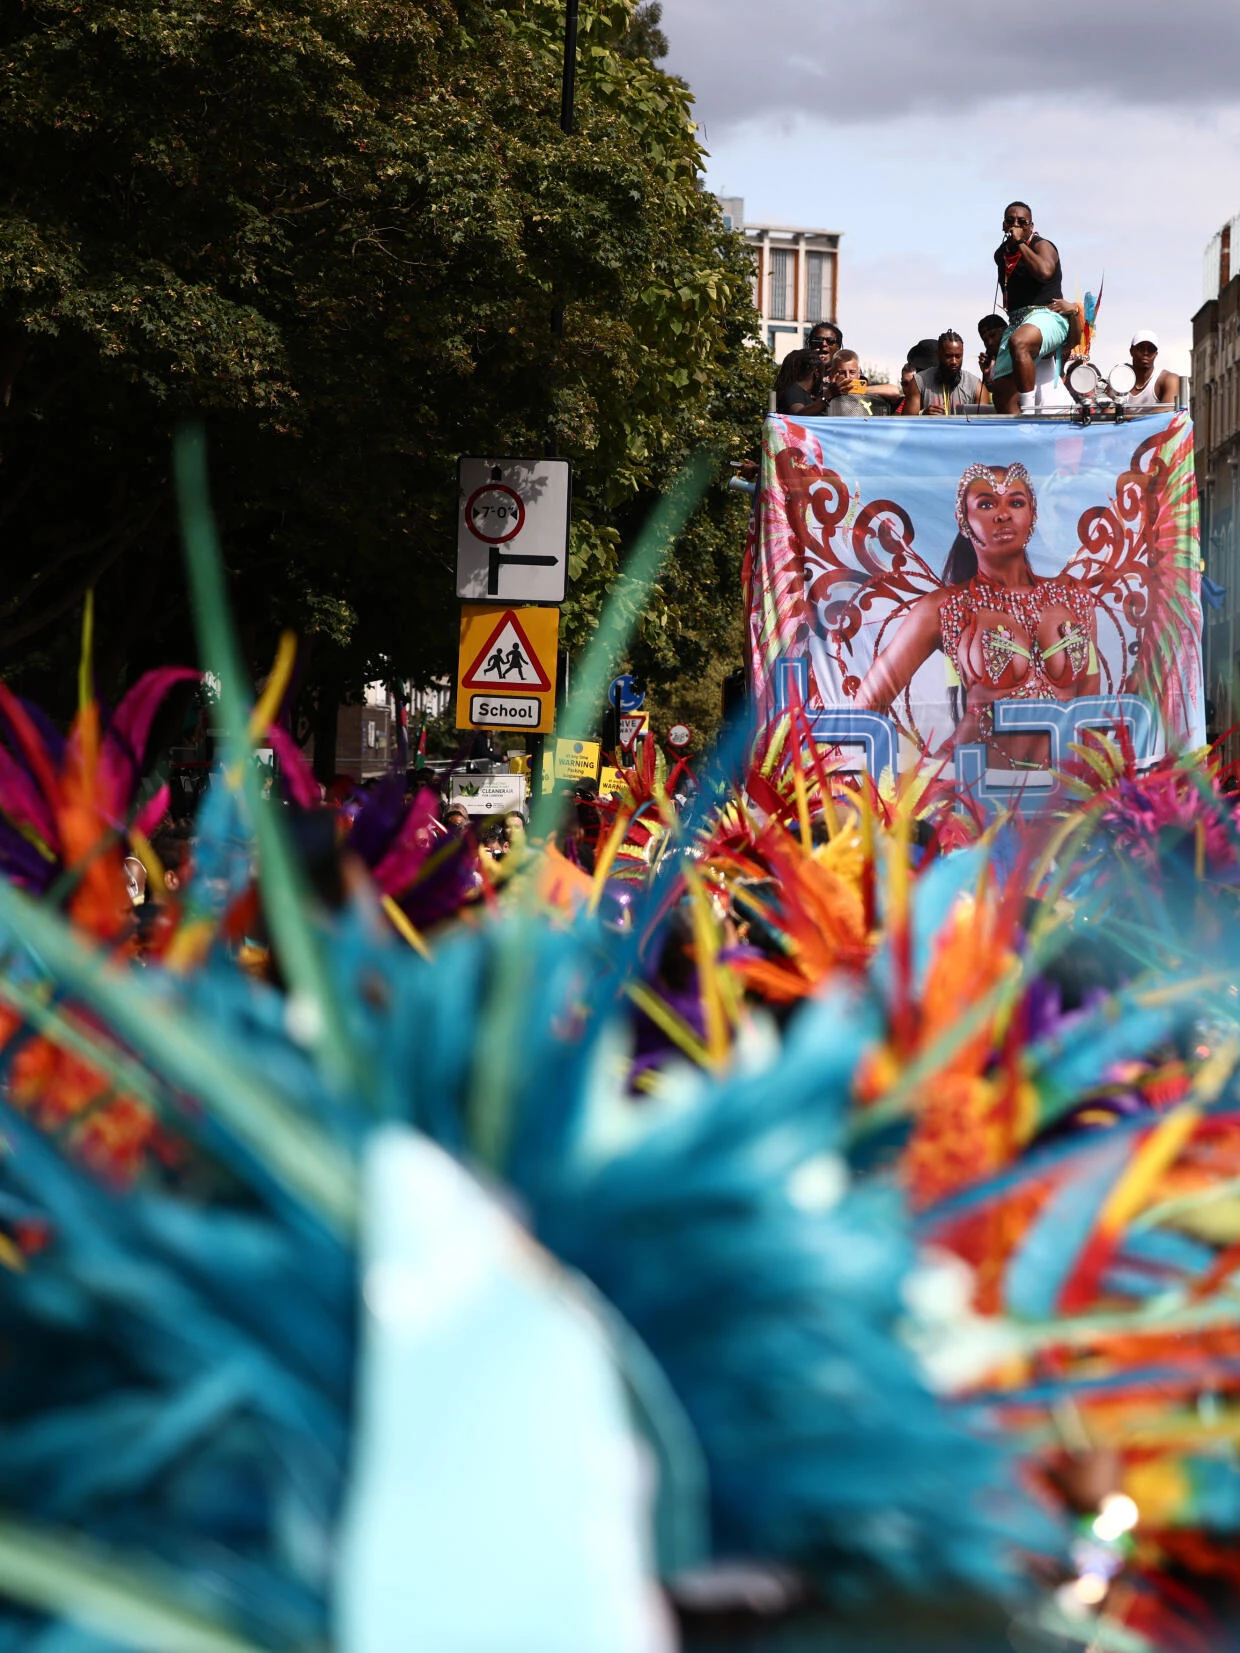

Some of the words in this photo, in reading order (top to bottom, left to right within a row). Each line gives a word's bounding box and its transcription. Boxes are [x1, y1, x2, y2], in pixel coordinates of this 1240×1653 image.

[478, 702, 534, 720] School
[620, 719, 637, 727] IVE
[559, 758, 594, 769] WARNING
